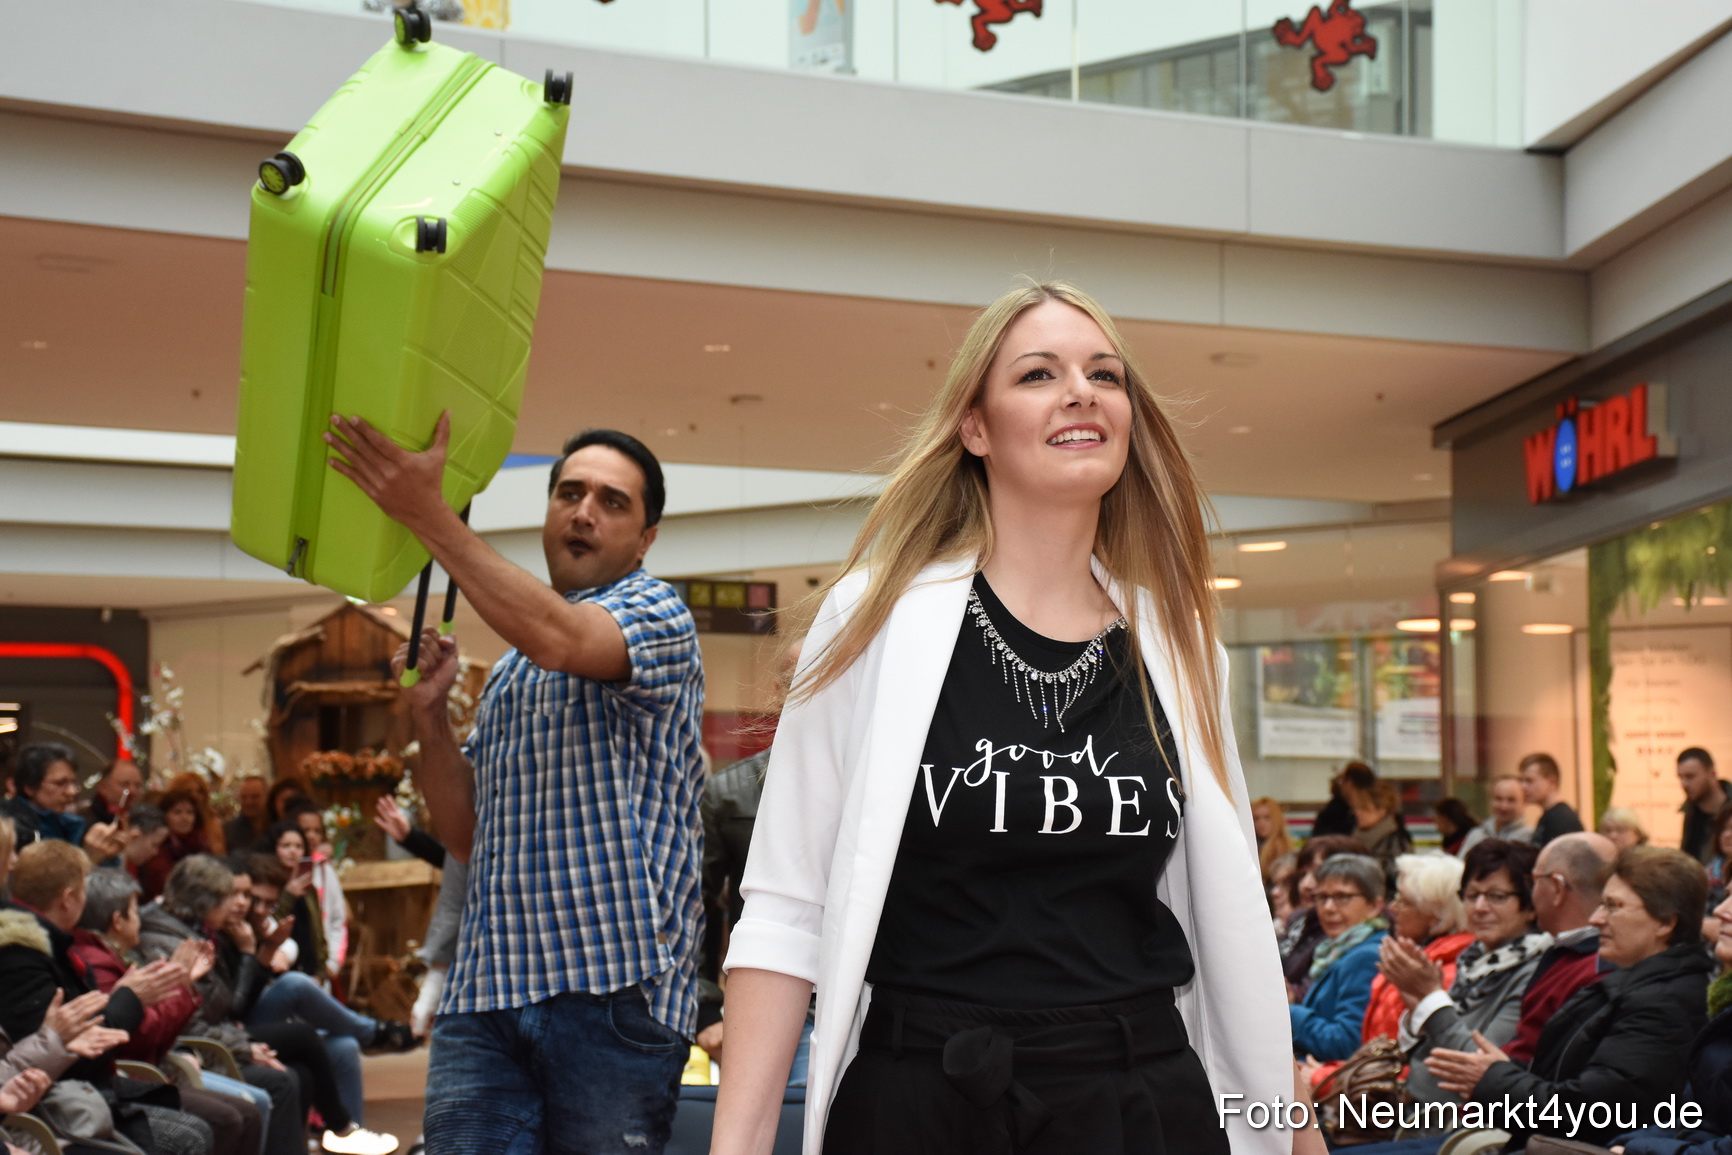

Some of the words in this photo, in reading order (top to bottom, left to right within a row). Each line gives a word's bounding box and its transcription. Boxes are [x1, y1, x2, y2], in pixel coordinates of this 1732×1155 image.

[1523, 383, 1658, 505] WÖHRL
[963, 734, 1119, 787] good
[920, 763, 1181, 839] VIBES
